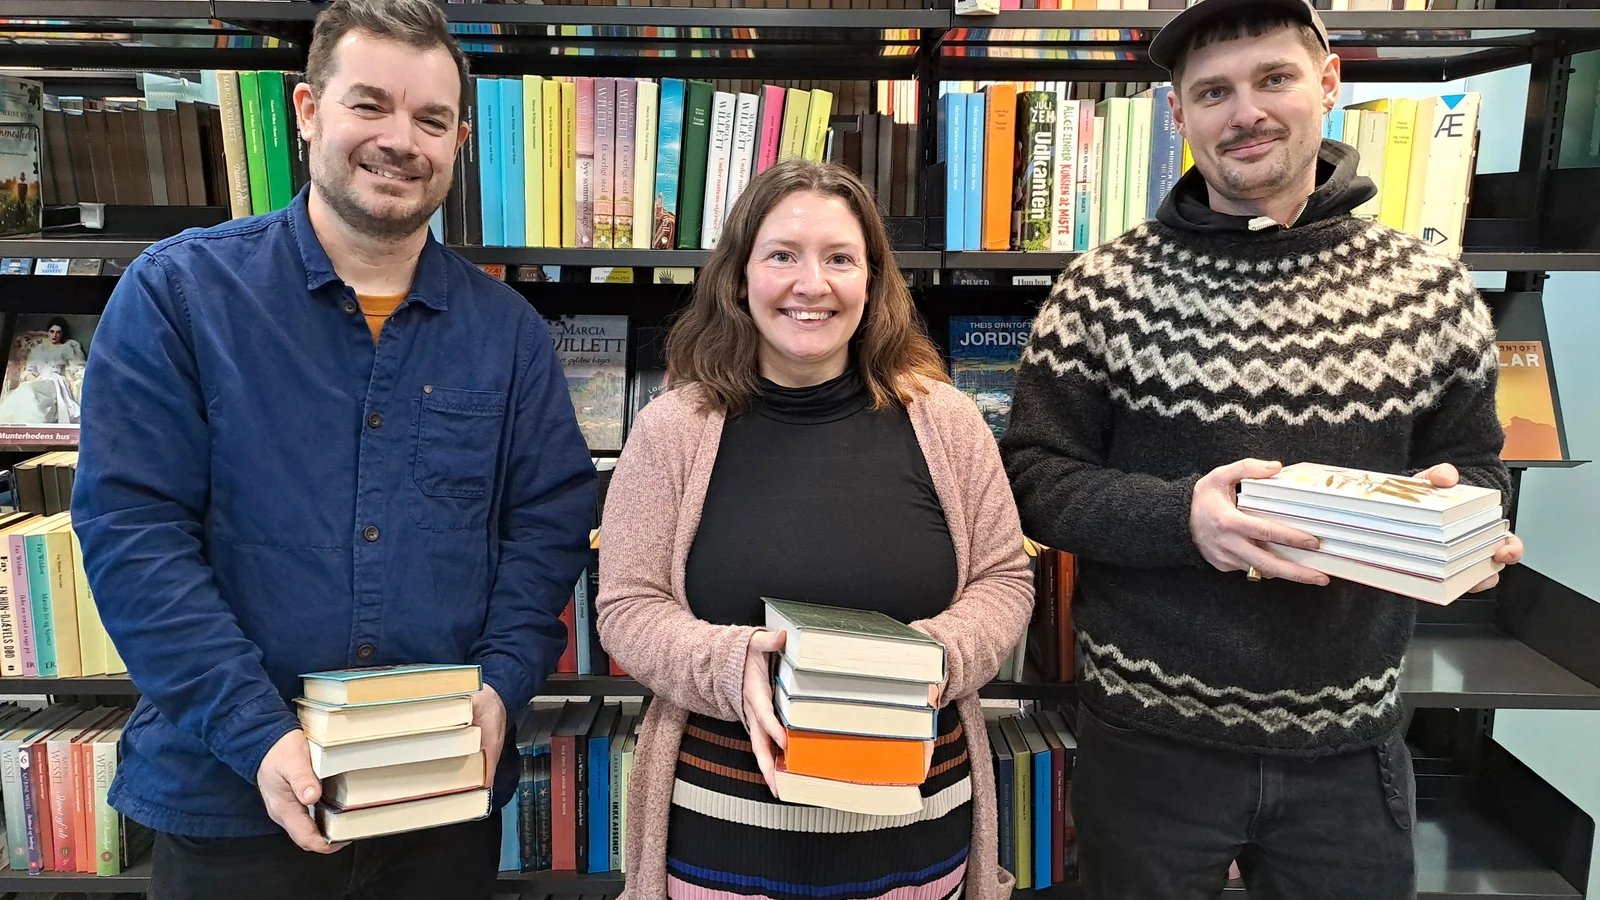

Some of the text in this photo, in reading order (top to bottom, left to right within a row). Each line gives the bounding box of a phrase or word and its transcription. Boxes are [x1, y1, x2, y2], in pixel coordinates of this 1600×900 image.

[597, 86, 607, 139] WILLETT
[619, 88, 628, 141] WILLETT
[1031, 110, 1055, 123] ZEH
[1034, 101, 1052, 110] JULI
[715, 100, 726, 151] WILLETT
[737, 102, 750, 152] WILLETT
[747, 113, 755, 142] MARCIA
[581, 161, 590, 176] Syv
[600, 153, 608, 176] særligt
[621, 155, 629, 178] særligt
[739, 158, 747, 178] Under
[1031, 131, 1052, 219] Udkanten
[715, 179, 723, 203] nattens
[562, 324, 605, 335] MARCIA
[0, 432, 53, 440] Munterhedens
[36, 544, 44, 552] Fay
[0, 556, 8, 573] Fay
[0, 586, 15, 658] EN HUN-DJÆVELS DØD
[3, 750, 15, 784] WESSEL
[51, 750, 61, 784] WESSEL
[96, 754, 106, 791] WESSEL
